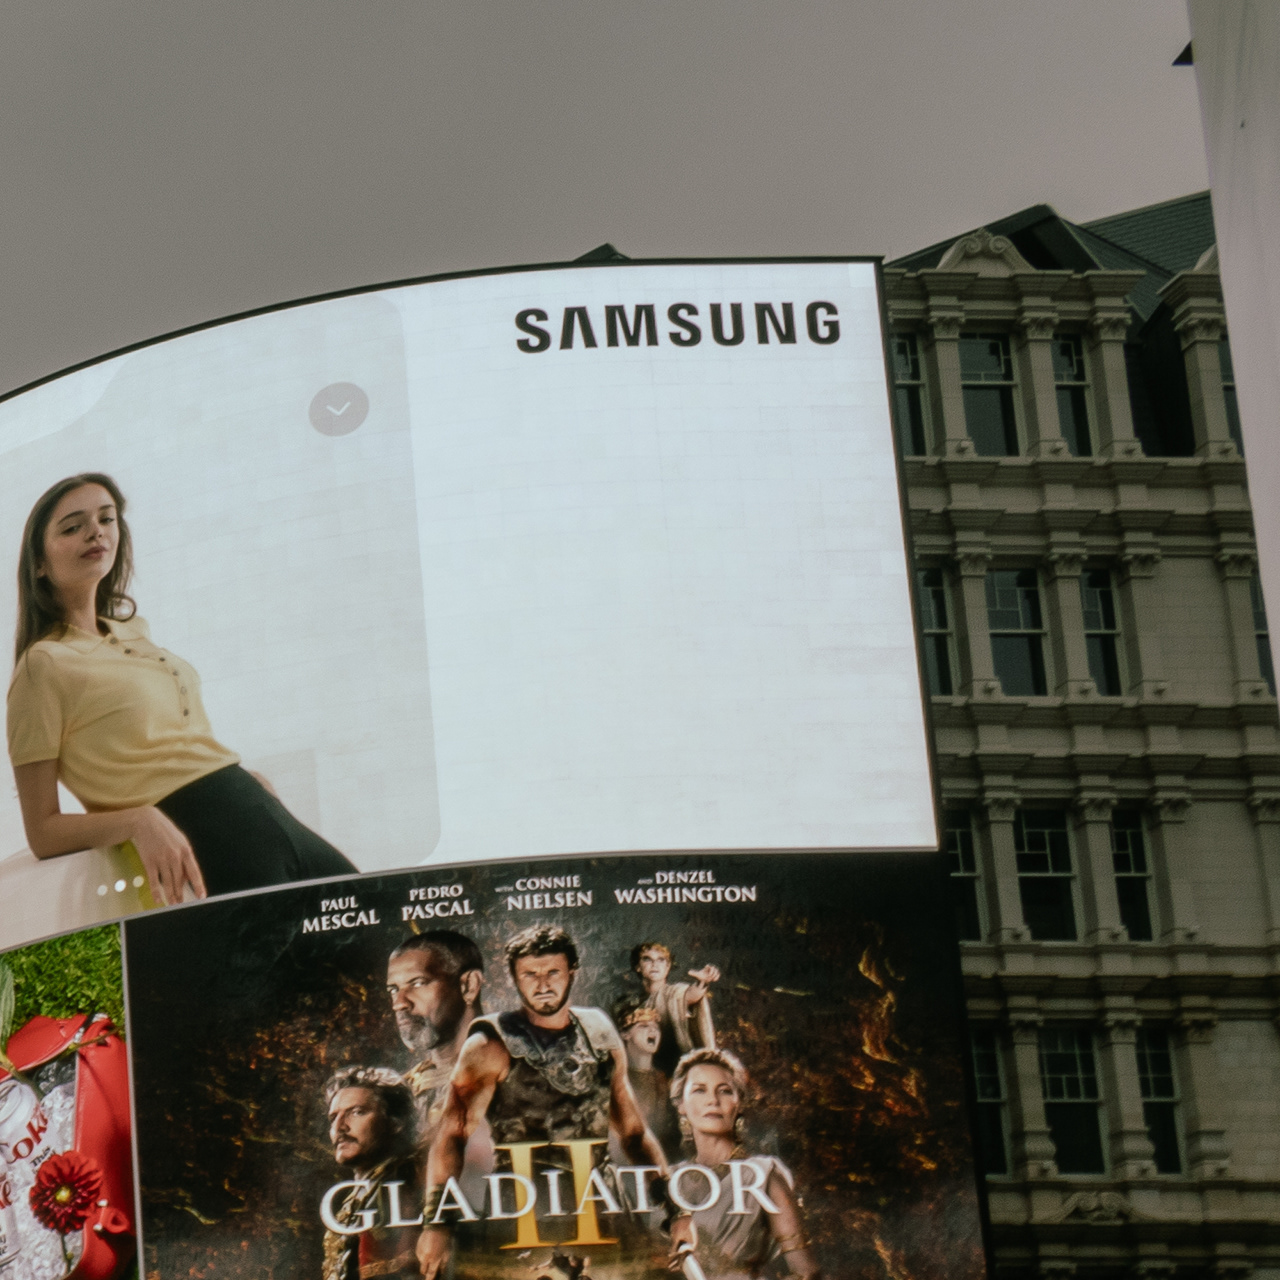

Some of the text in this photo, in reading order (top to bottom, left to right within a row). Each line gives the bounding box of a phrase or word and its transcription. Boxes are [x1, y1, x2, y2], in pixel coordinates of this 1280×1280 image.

[515, 301, 841, 353] SAMSUNG
[515, 875, 582, 892] CONNIE
[655, 870, 715, 885] DENZEL
[409, 884, 463, 901] PEDRO
[507, 890, 593, 911] NIELSEN
[614, 886, 757, 904] WASHINGTON
[321, 895, 359, 912] PAUL
[401, 899, 474, 921] PASCAL
[302, 909, 380, 934] MESCAL
[319, 1158, 783, 1235] GLADIATOR
